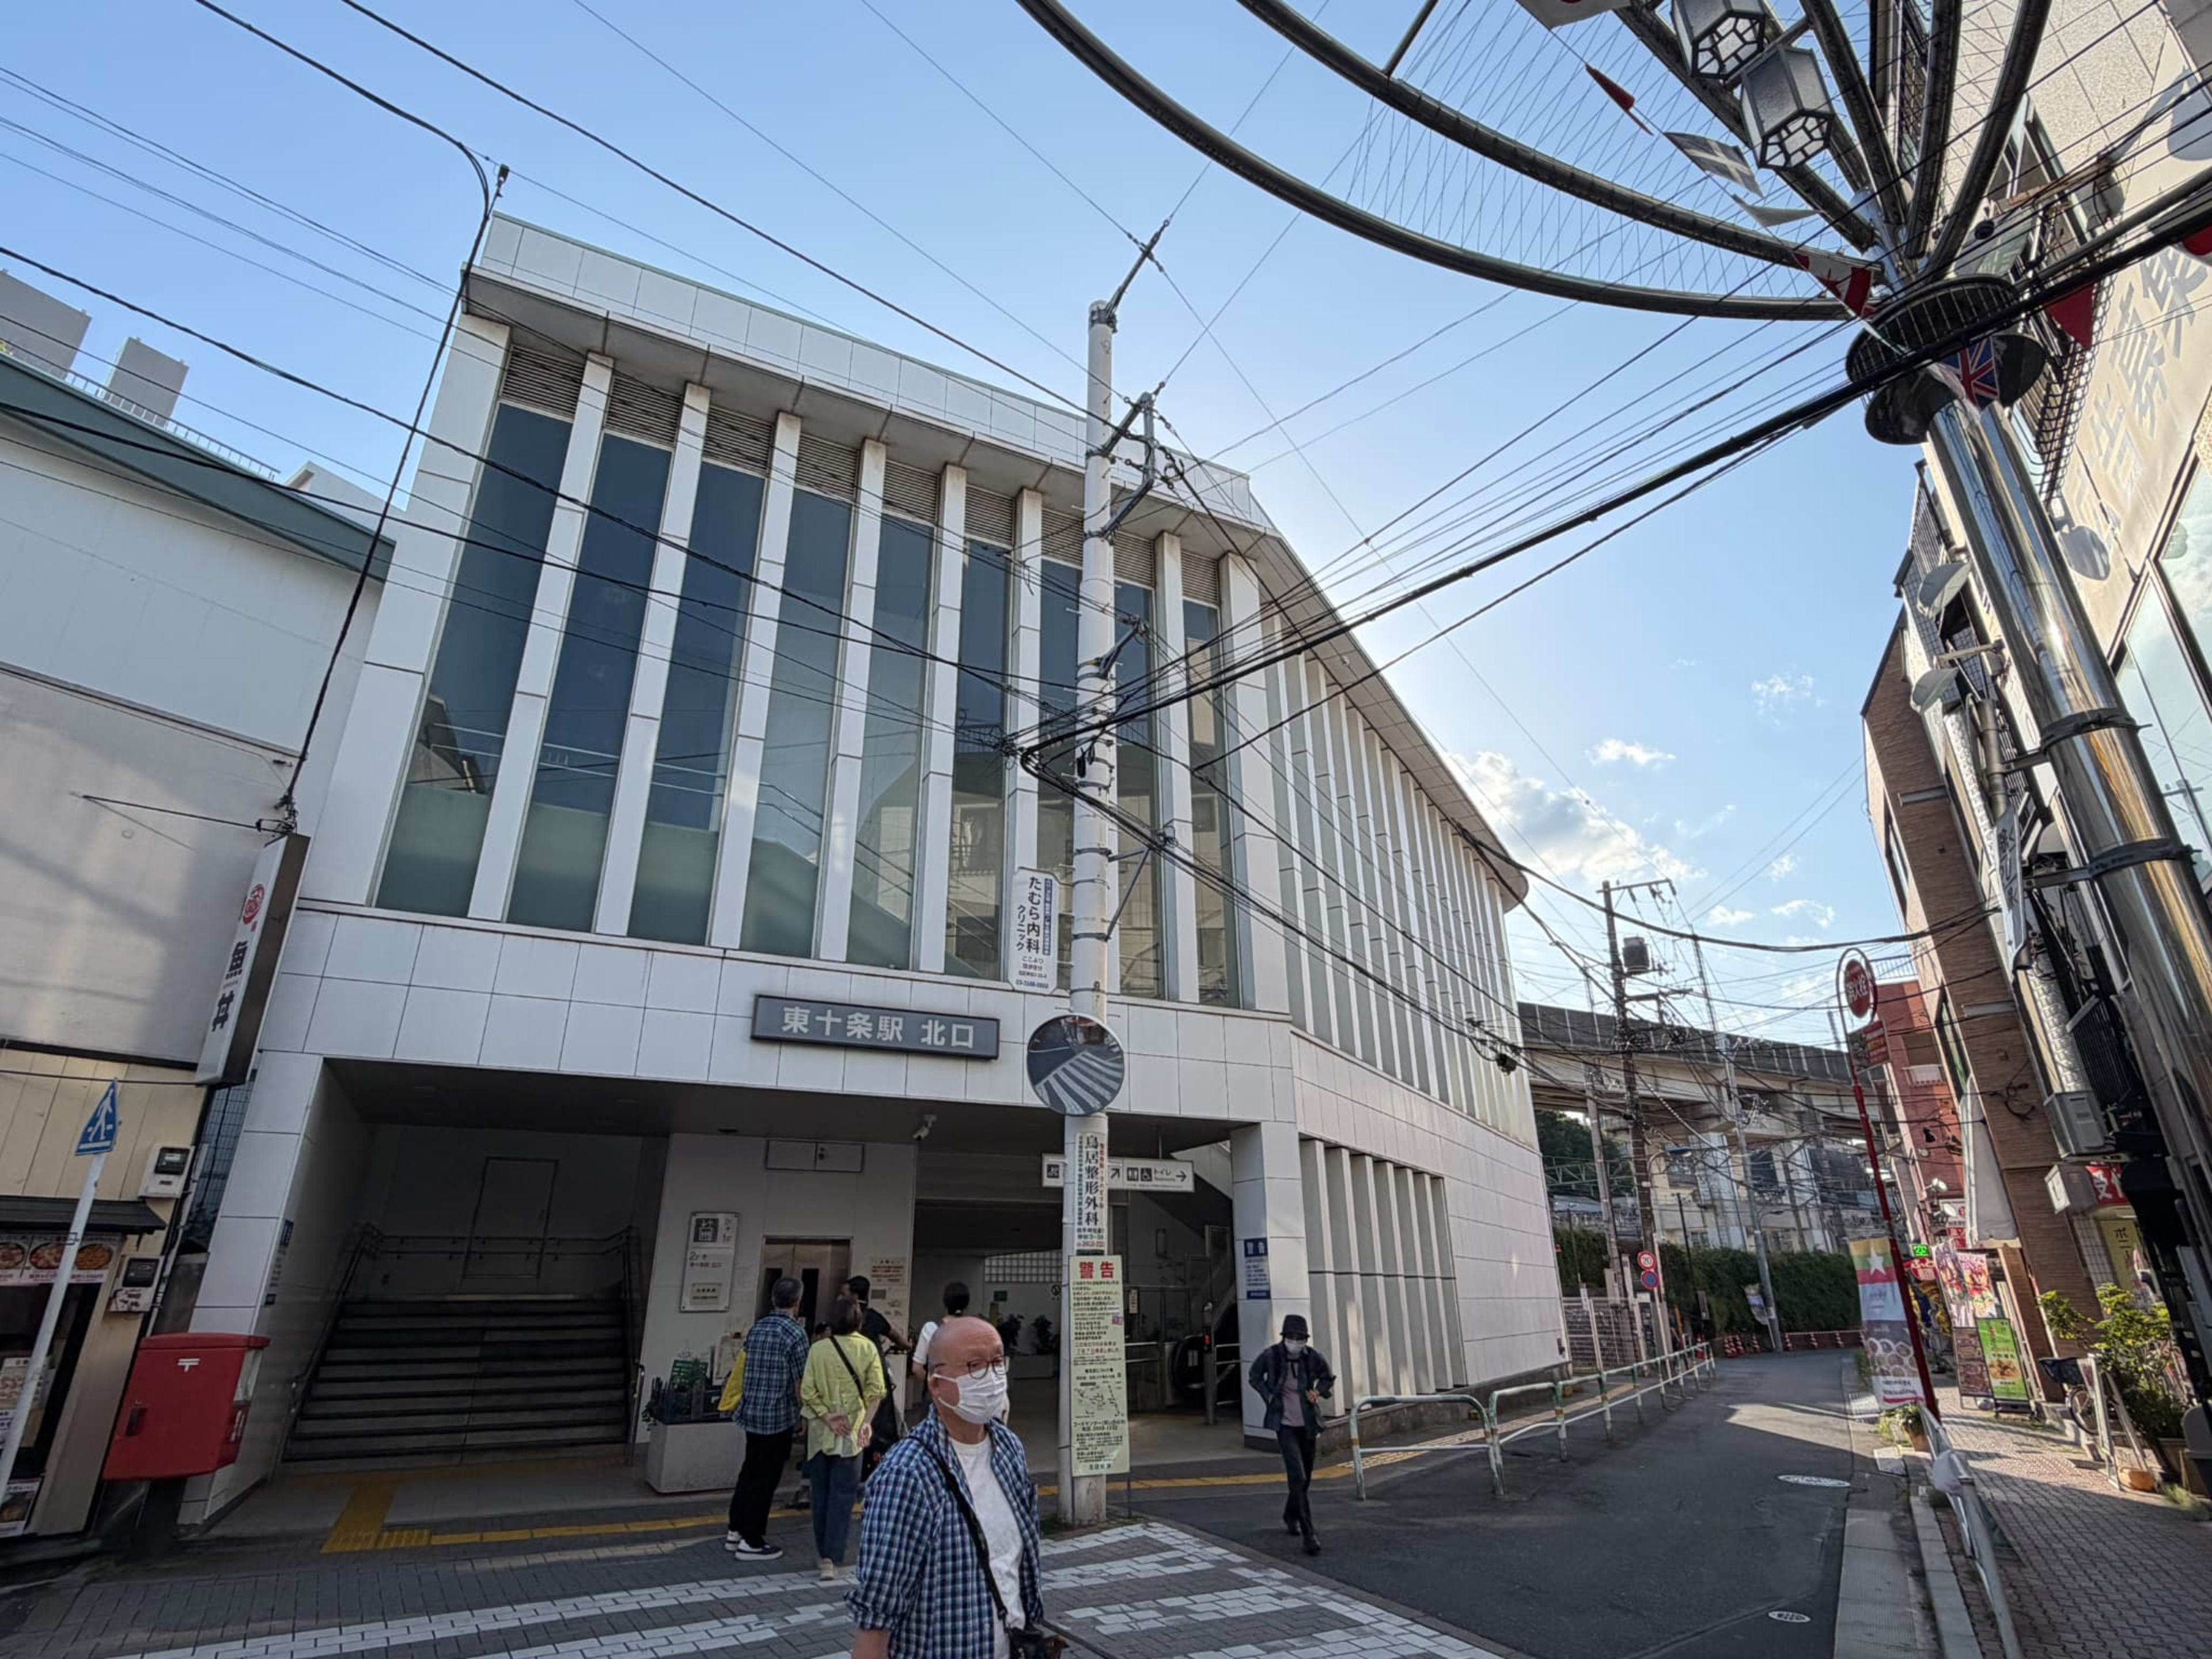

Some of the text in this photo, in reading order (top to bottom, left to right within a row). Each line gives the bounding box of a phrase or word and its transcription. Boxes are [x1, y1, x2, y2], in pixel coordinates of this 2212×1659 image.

[1016, 904, 1026, 952] クリニック
[1026, 876, 1042, 955] たむら内科
[781, 1006, 975, 1050] 東十条駅 北口
[1084, 1135, 1099, 1226] 鳥居整形外科
[1079, 1261, 1115, 1279] 警告
